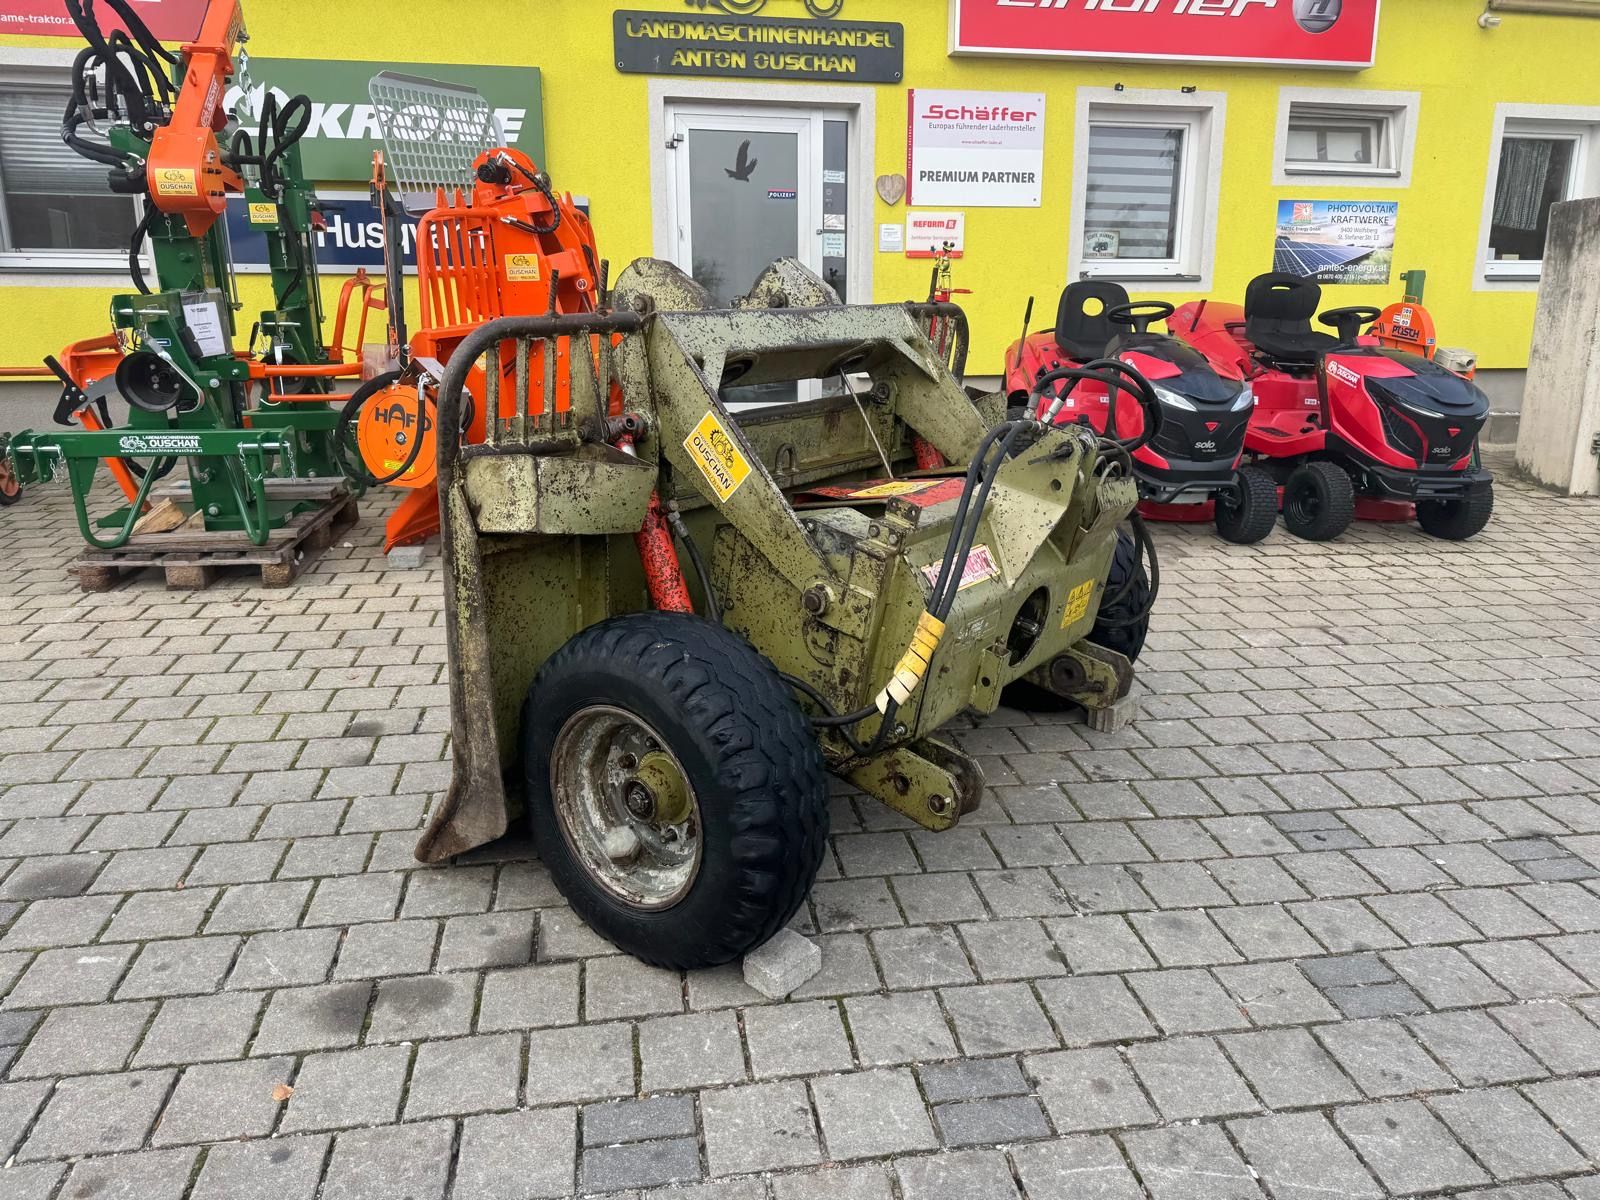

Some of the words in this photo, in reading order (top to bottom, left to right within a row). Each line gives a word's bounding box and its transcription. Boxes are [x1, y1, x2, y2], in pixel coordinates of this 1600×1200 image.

[625, 17, 895, 48] LANDMASCHINENHANDEL
[671, 49, 747, 69] ANTON
[752, 50, 856, 73] OUSCHAN
[921, 105, 1038, 122] Schäffer
[928, 122, 955, 130] Europas
[956, 122, 988, 131] führender
[989, 123, 1036, 132] Laderhersteller
[919, 170, 979, 183] PREMIUM
[982, 172, 1035, 184] PARTNER
[1327, 204, 1394, 214] PHOTOVOLTAIK
[913, 220, 945, 228] REFORM
[1331, 215, 1389, 224] KRAFTWERKE
[1317, 264, 1388, 273] amtec-energy.at
[149, 439, 199, 447] OUSCHAN
[1194, 440, 1216, 449] solo
[693, 436, 731, 489] OUSCHAN
